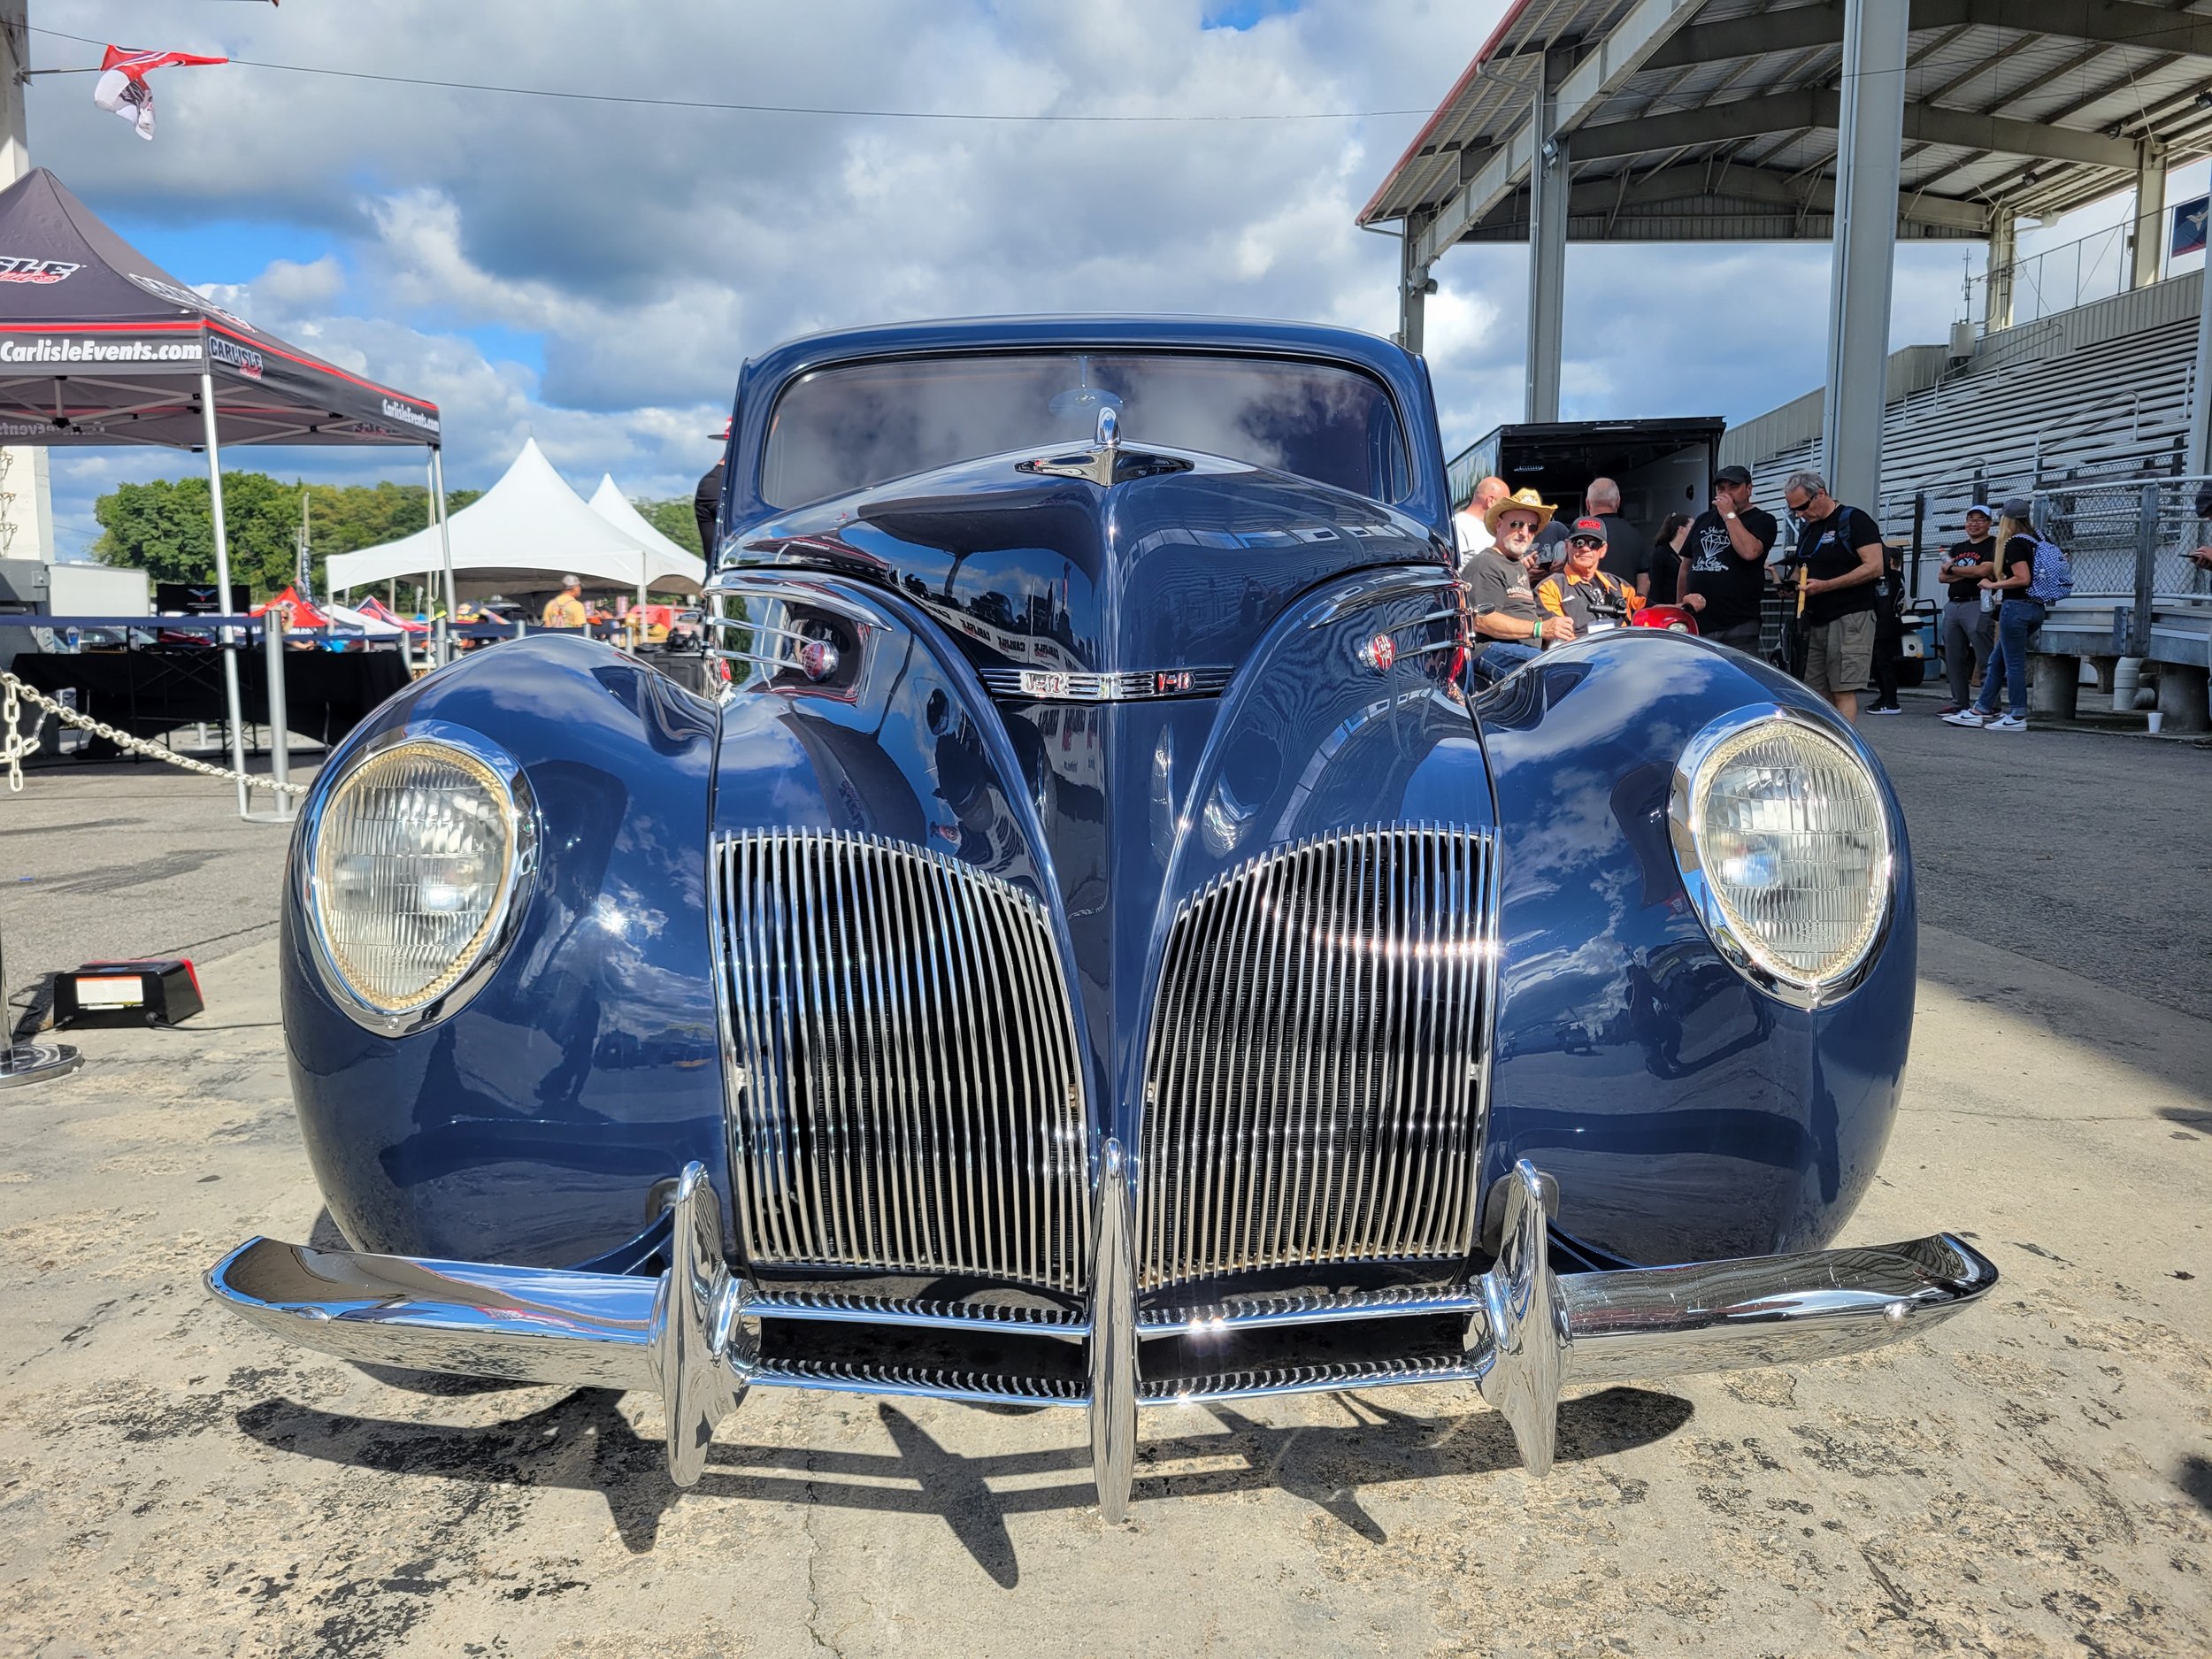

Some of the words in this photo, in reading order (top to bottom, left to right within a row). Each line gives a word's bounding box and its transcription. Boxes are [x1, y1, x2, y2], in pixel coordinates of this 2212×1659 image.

[0, 339, 203, 362] CarlisleEvents.com
[209, 336, 263, 370] CARLISLE
[382, 398, 440, 433] CarlisleEvents.com
